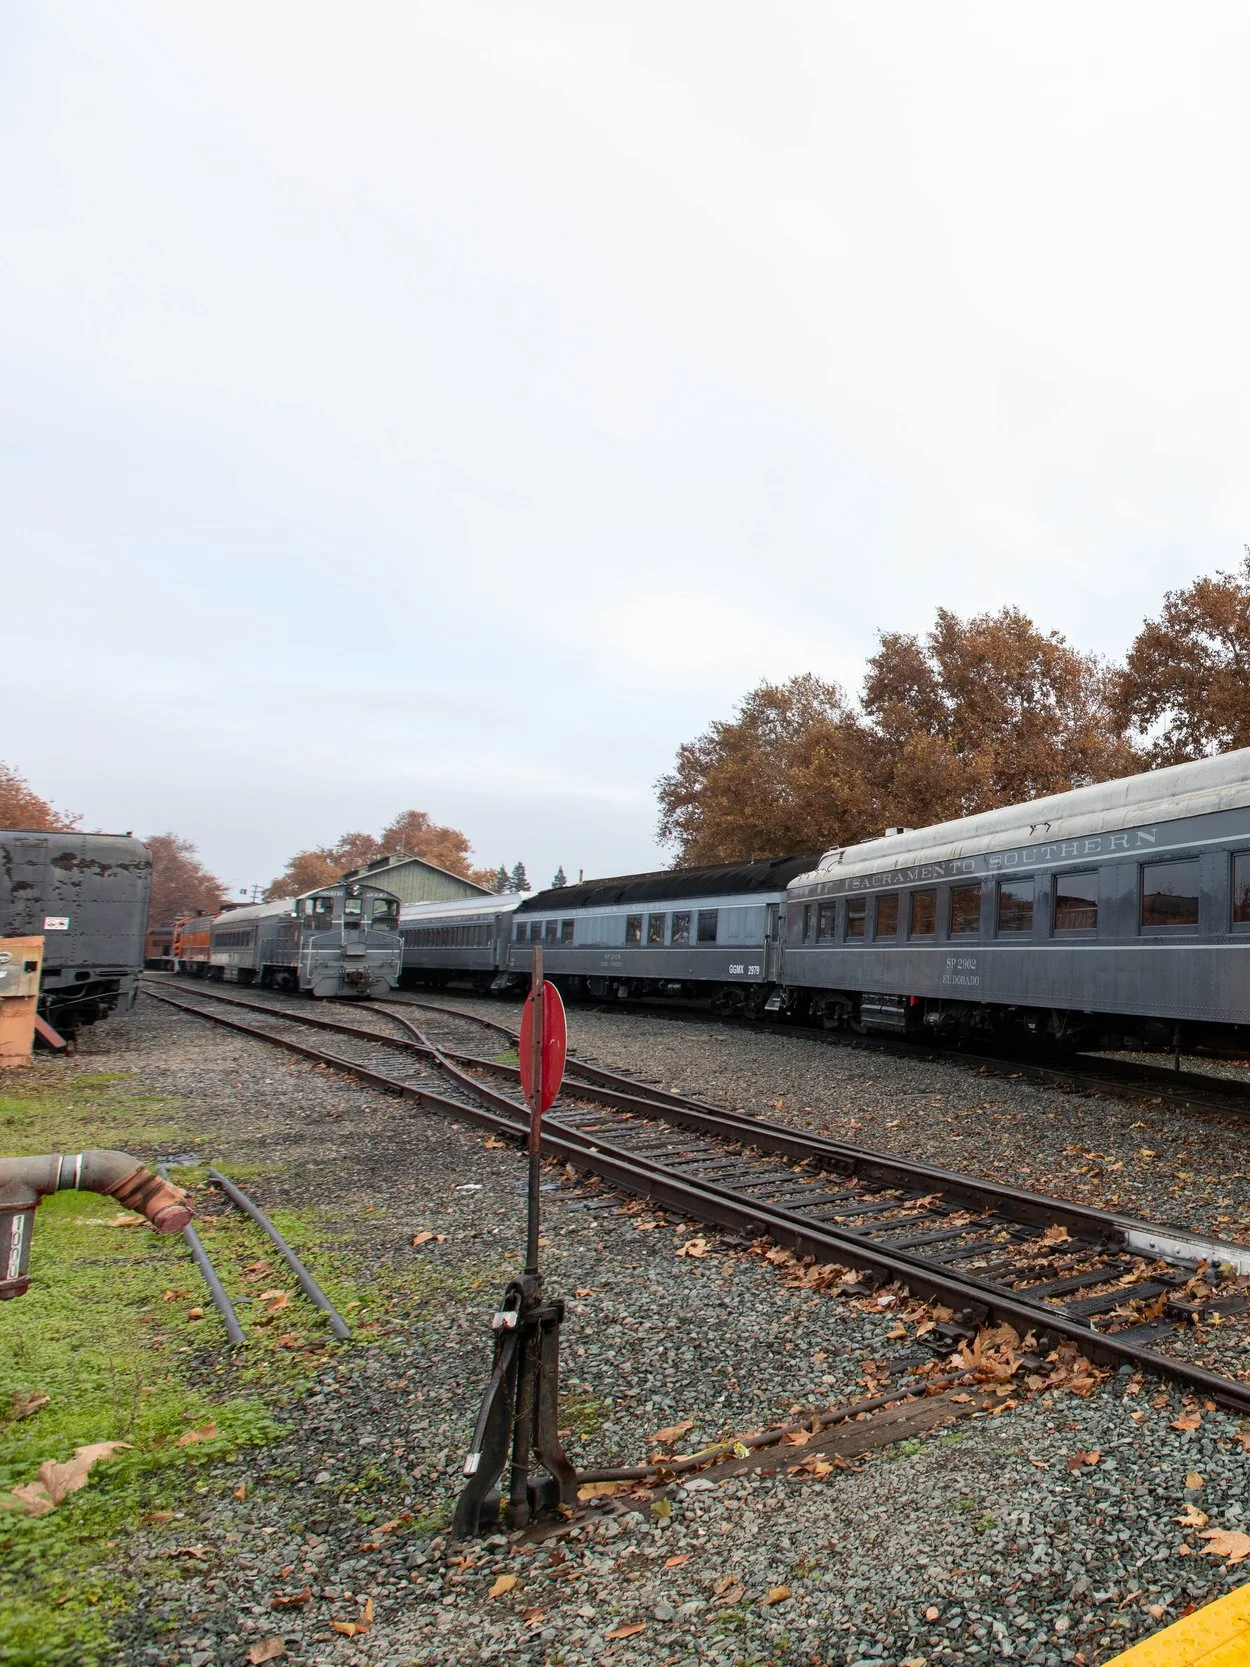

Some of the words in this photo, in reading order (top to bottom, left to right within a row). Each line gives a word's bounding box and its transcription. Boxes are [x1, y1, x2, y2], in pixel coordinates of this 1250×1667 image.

[851, 860, 974, 888] SACRAMENTO
[989, 828, 1158, 868] SOUTHERN
[942, 974, 952, 984] EL
[952, 975, 980, 985] DORADO
[946, 958, 956, 969] SP
[957, 958, 977, 969] 2902
[9, 1215, 22, 1278] 1000
